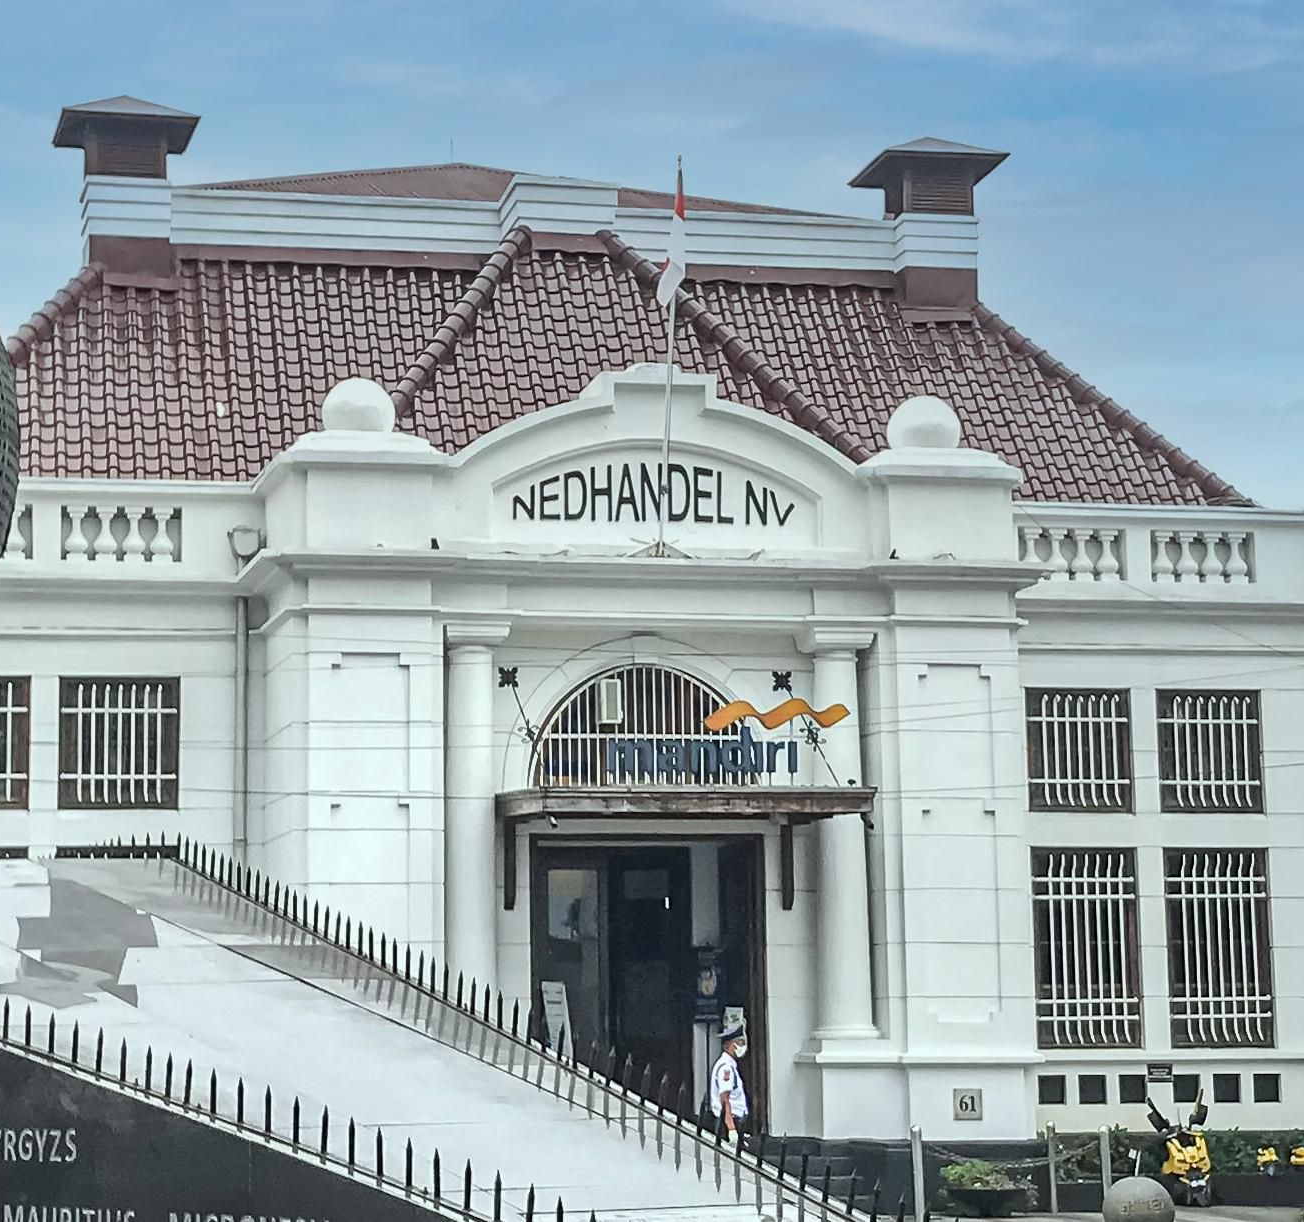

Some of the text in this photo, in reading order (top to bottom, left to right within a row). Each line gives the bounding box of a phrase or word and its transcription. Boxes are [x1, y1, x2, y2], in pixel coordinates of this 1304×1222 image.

[512, 462, 795, 526] NEDHANDEL NV
[606, 725, 798, 777] mandiri
[959, 1095, 977, 1112] 61
